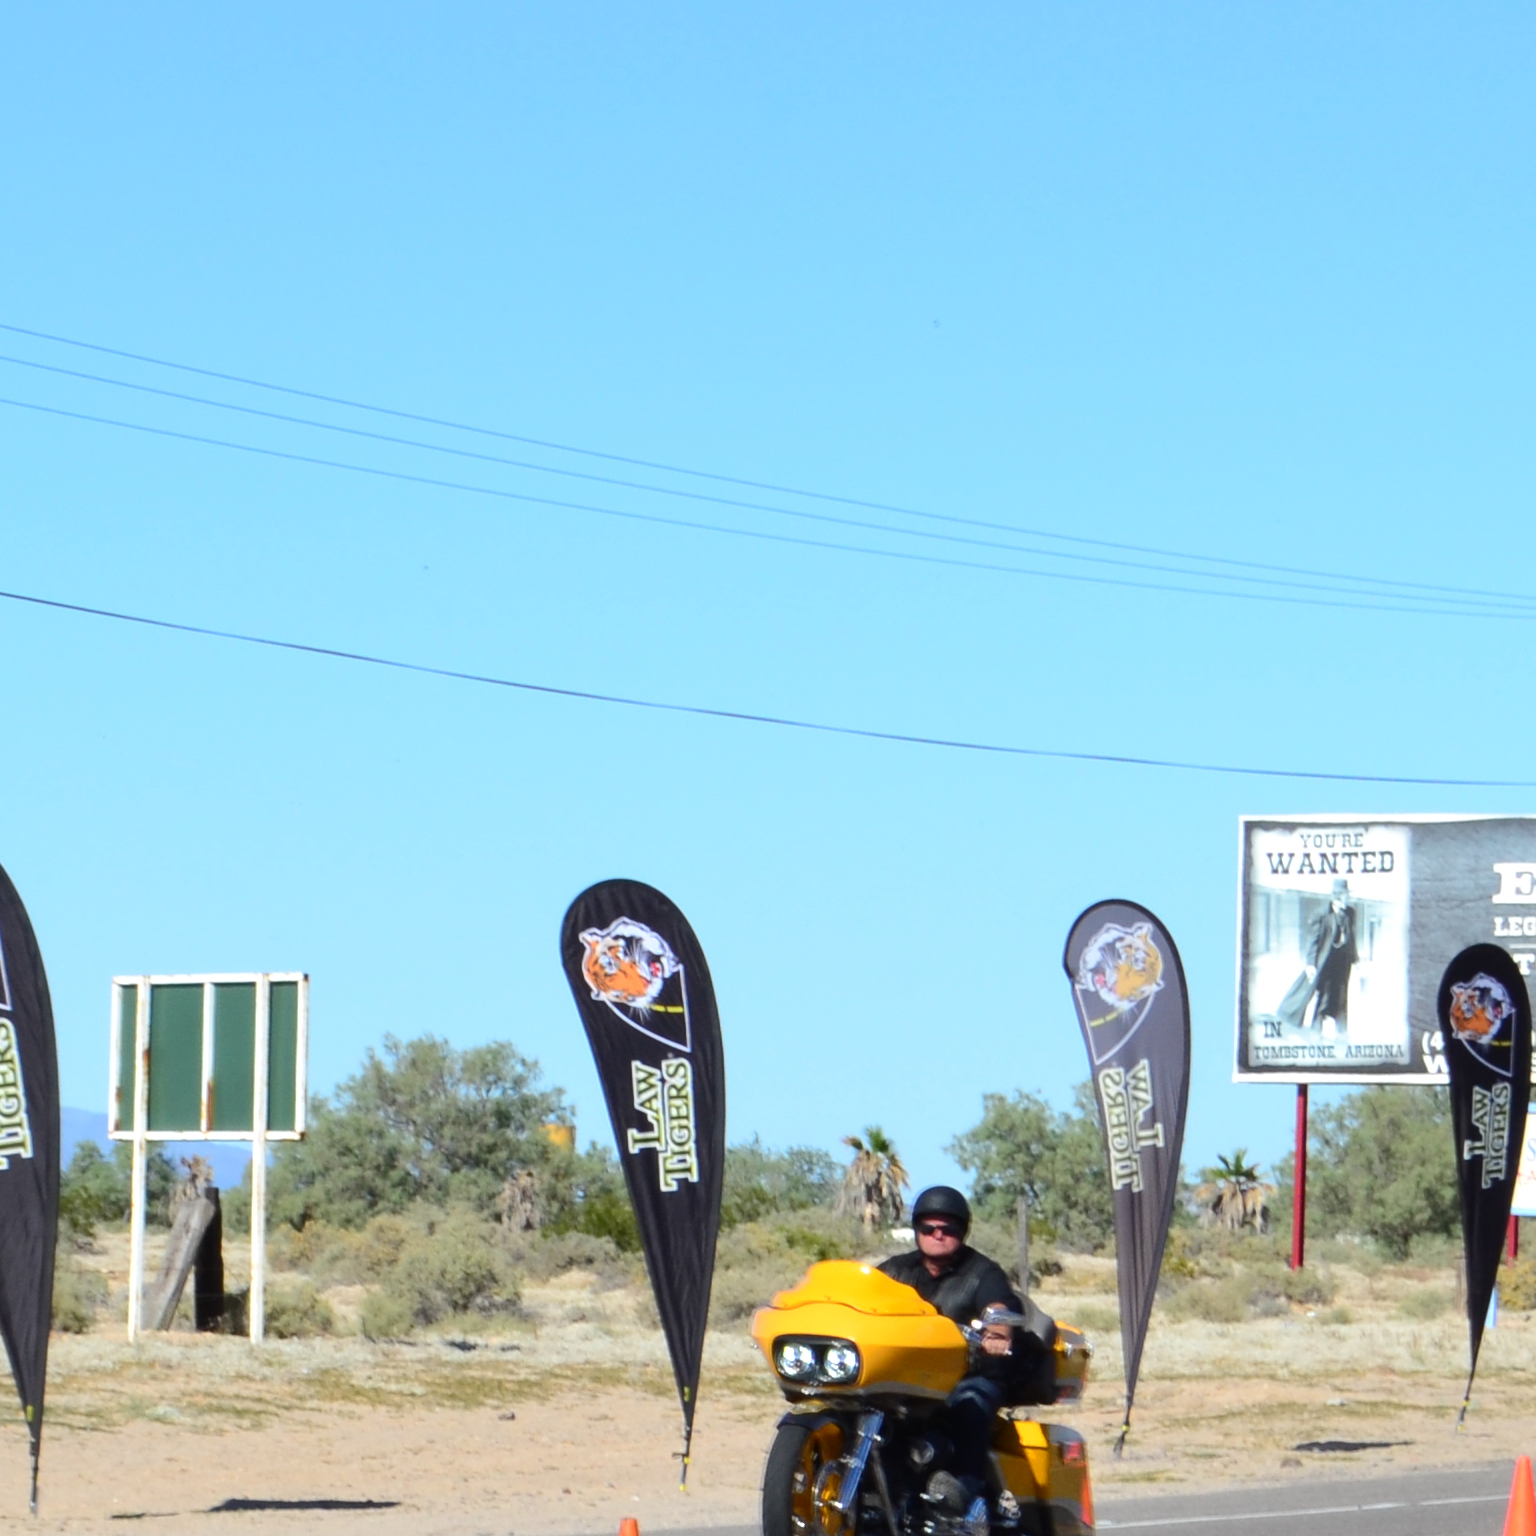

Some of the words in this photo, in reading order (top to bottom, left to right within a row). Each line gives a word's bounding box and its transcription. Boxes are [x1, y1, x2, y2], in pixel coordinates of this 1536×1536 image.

[1300, 833, 1363, 848] YOU'RE
[1267, 852, 1394, 874] WANTED
[1263, 1021, 1282, 1038] IN
[1345, 1044, 1404, 1059] ARIZONA
[628, 1060, 664, 1154] LAW
[660, 1058, 699, 1192] TIGERS
